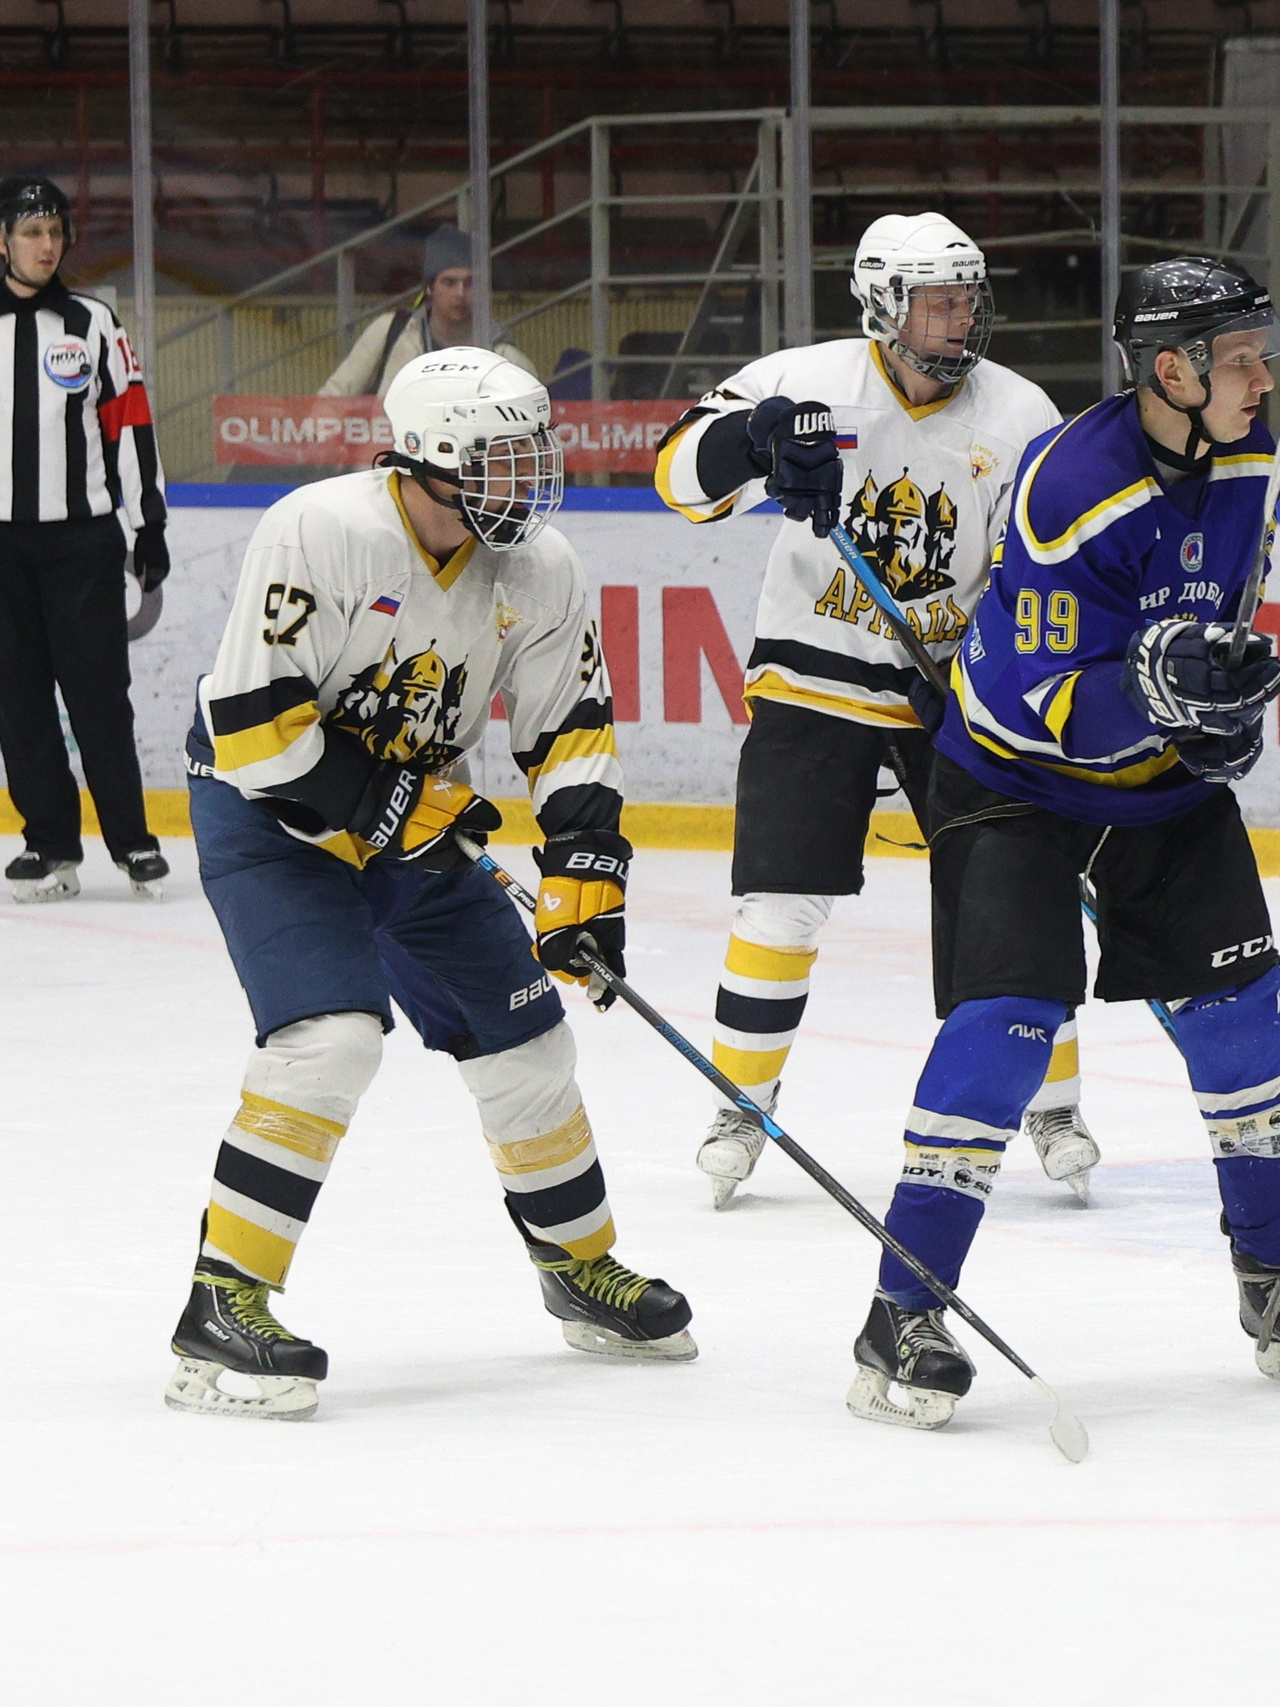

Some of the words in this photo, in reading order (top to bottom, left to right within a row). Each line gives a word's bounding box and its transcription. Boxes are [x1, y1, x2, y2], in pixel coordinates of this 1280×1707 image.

[951, 258, 981, 269] BAUER
[1133, 311, 1179, 323] BAUER
[421, 363, 480, 373] CCM
[264, 583, 316, 647] 97
[1015, 588, 1079, 655] 99
[366, 769, 417, 849] AUER
